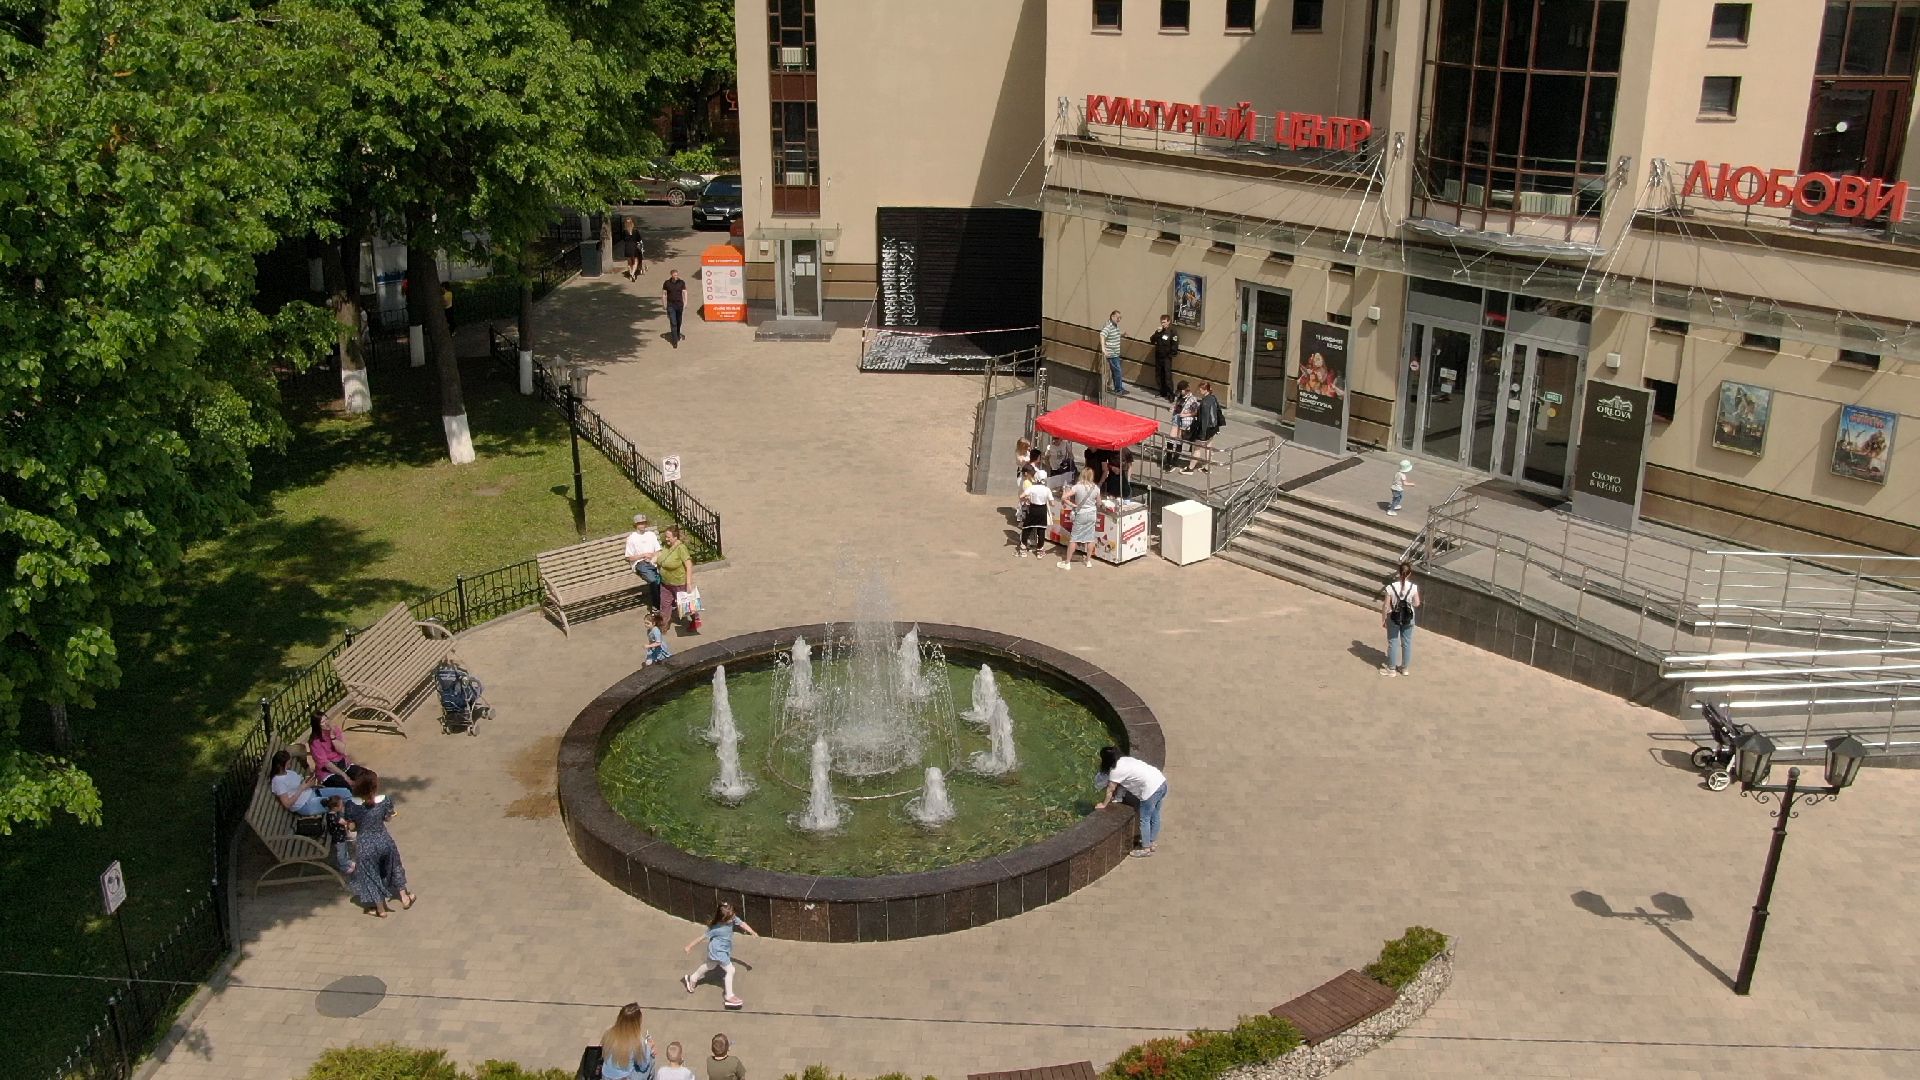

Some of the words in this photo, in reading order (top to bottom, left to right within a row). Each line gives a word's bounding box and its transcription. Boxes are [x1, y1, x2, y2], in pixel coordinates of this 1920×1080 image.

[1086, 94, 1256, 141] КУЛЬТУРНЫЙ
[1274, 111, 1371, 152] ЦЕНТР
[1680, 160, 1908, 222] ЛЮБОВИ
[1596, 405, 1631, 419] ORLOVA
